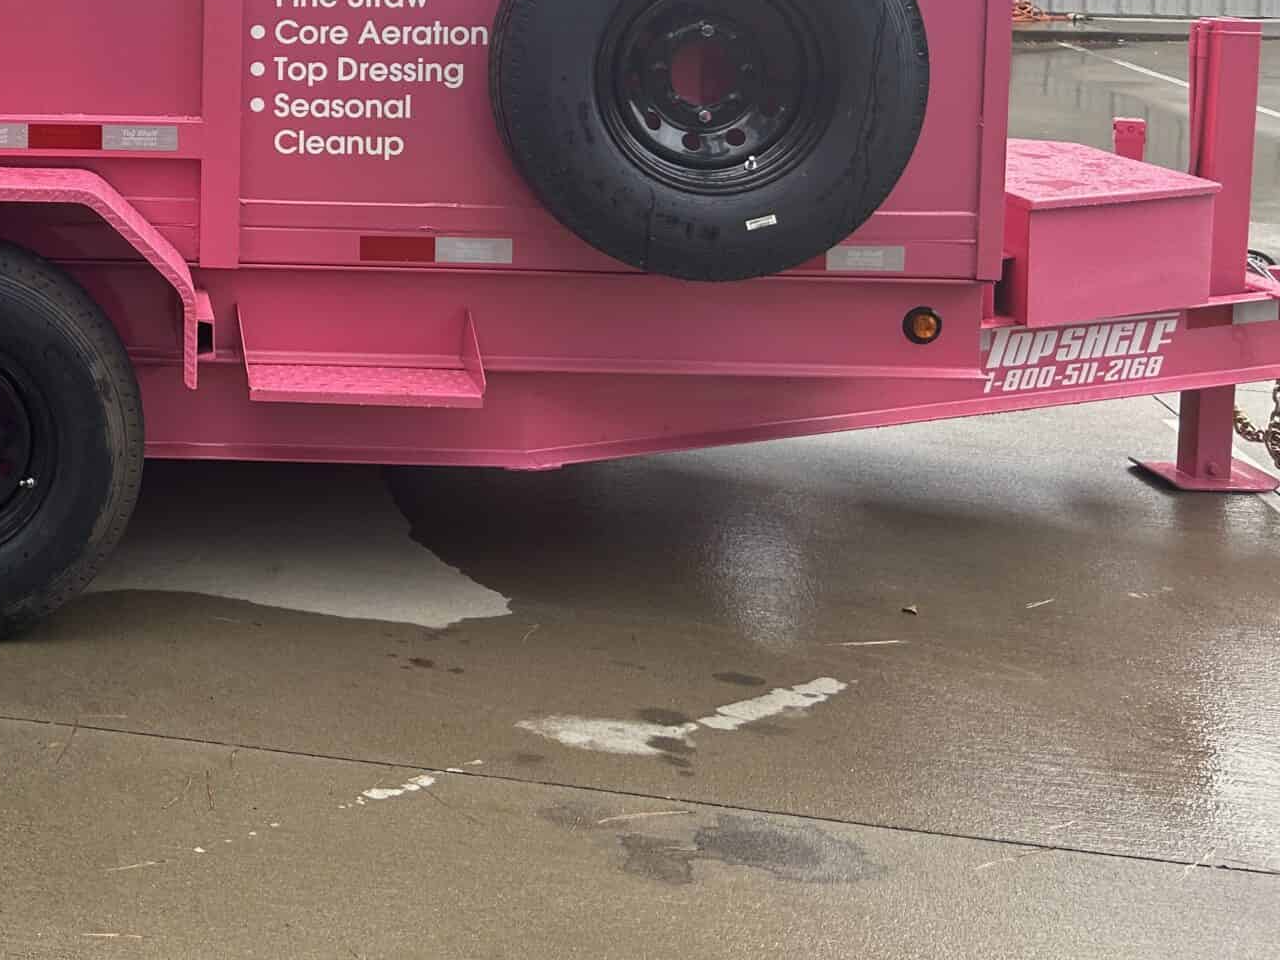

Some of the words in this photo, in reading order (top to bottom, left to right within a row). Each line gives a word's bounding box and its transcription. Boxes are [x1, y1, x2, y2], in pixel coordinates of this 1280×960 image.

[274, 19, 349, 46] Core
[358, 19, 489, 46] Aeration
[273, 56, 328, 87] Top
[337, 57, 464, 89] Dressing
[273, 93, 412, 119] Seasonal
[274, 129, 404, 161] Cleanup
[984, 356, 1164, 393] 1-800-511-2168
